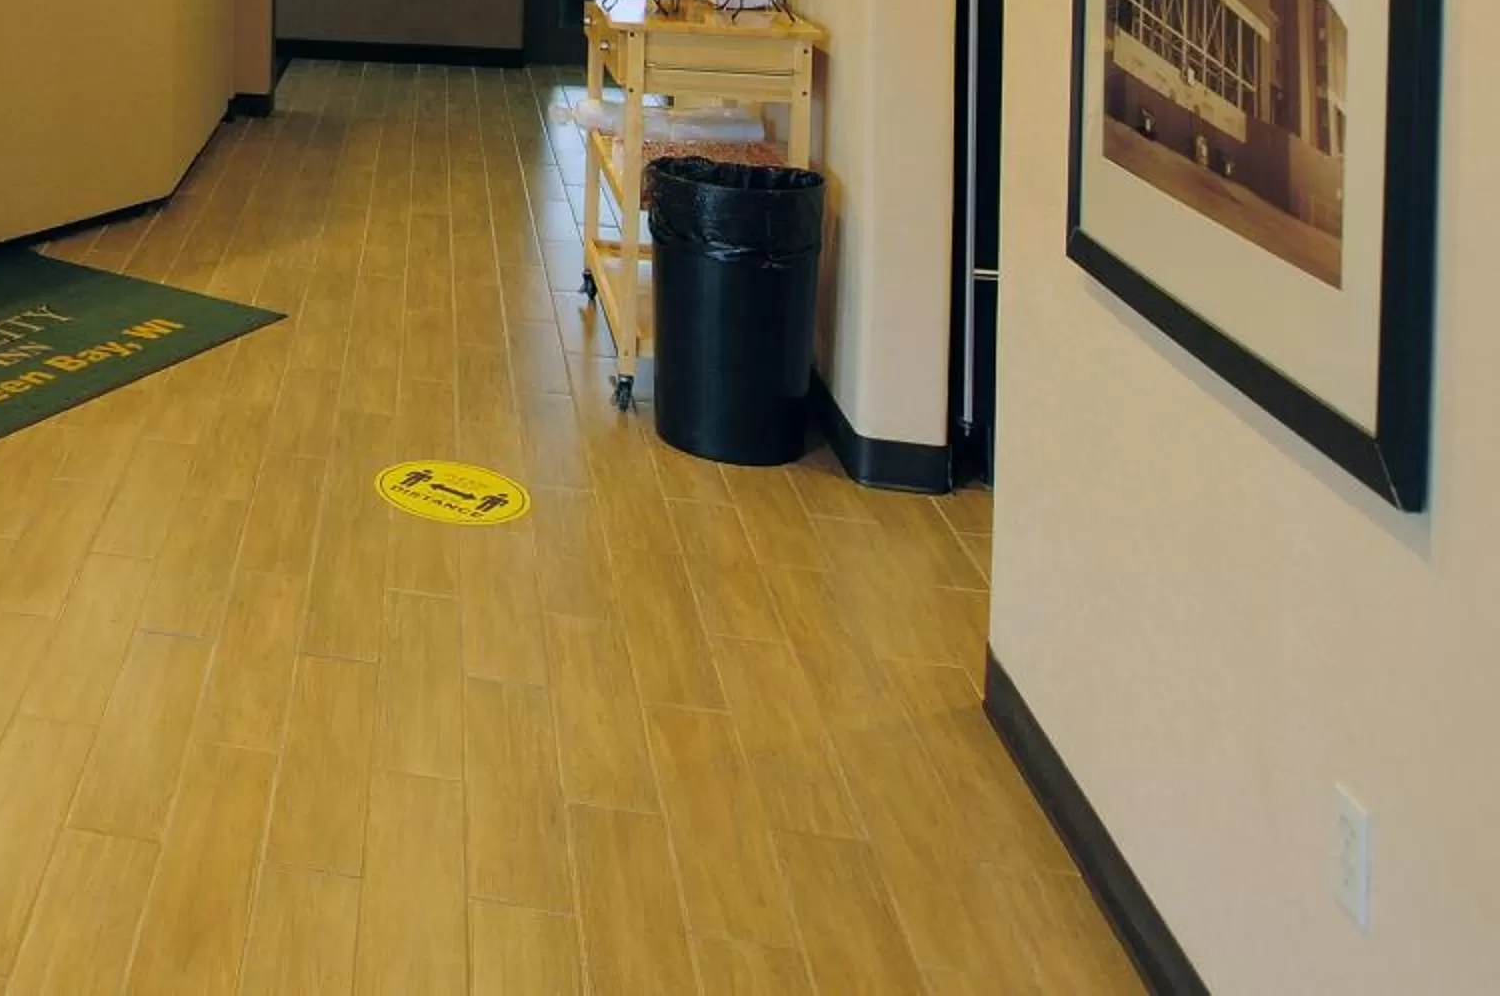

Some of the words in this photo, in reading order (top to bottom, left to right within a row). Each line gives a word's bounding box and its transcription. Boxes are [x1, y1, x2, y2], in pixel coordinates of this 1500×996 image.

[43, 340, 144, 373] Bay,
[122, 318, 186, 340] WI
[389, 484, 485, 518] DISTANCE
